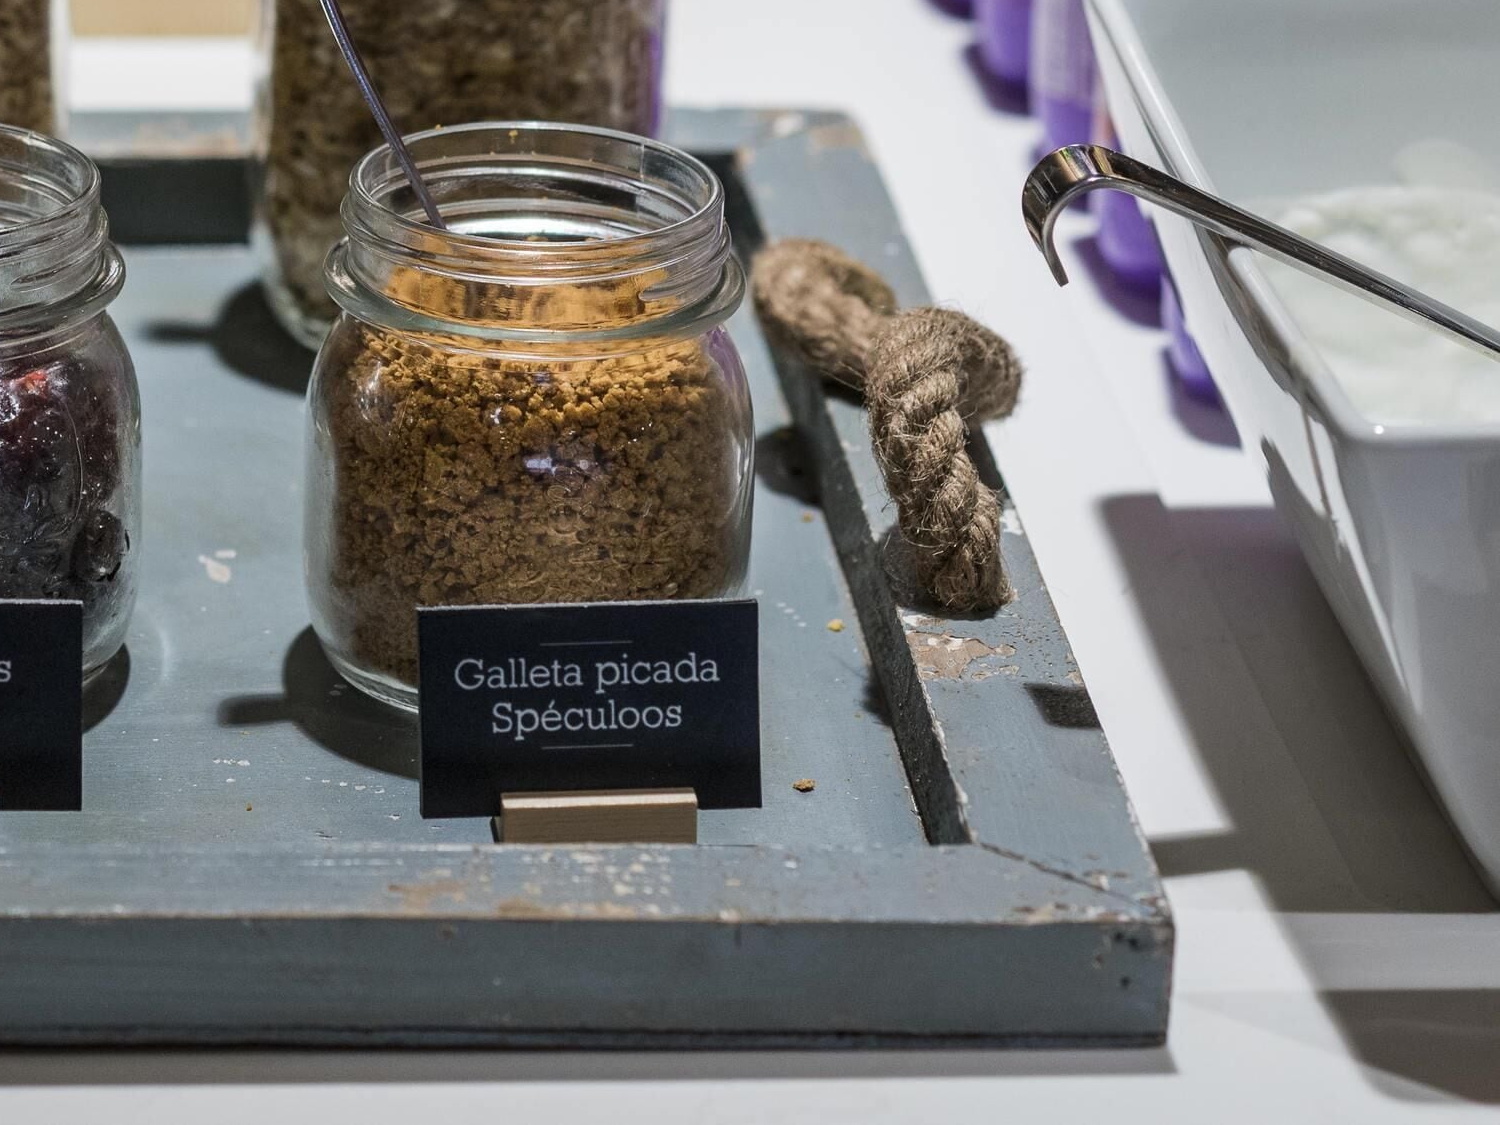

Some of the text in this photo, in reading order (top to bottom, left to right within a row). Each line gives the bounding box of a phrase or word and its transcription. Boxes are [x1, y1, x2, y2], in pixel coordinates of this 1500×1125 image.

[453, 651, 721, 695] Galleta picada
[491, 698, 683, 741] Spéculoos
